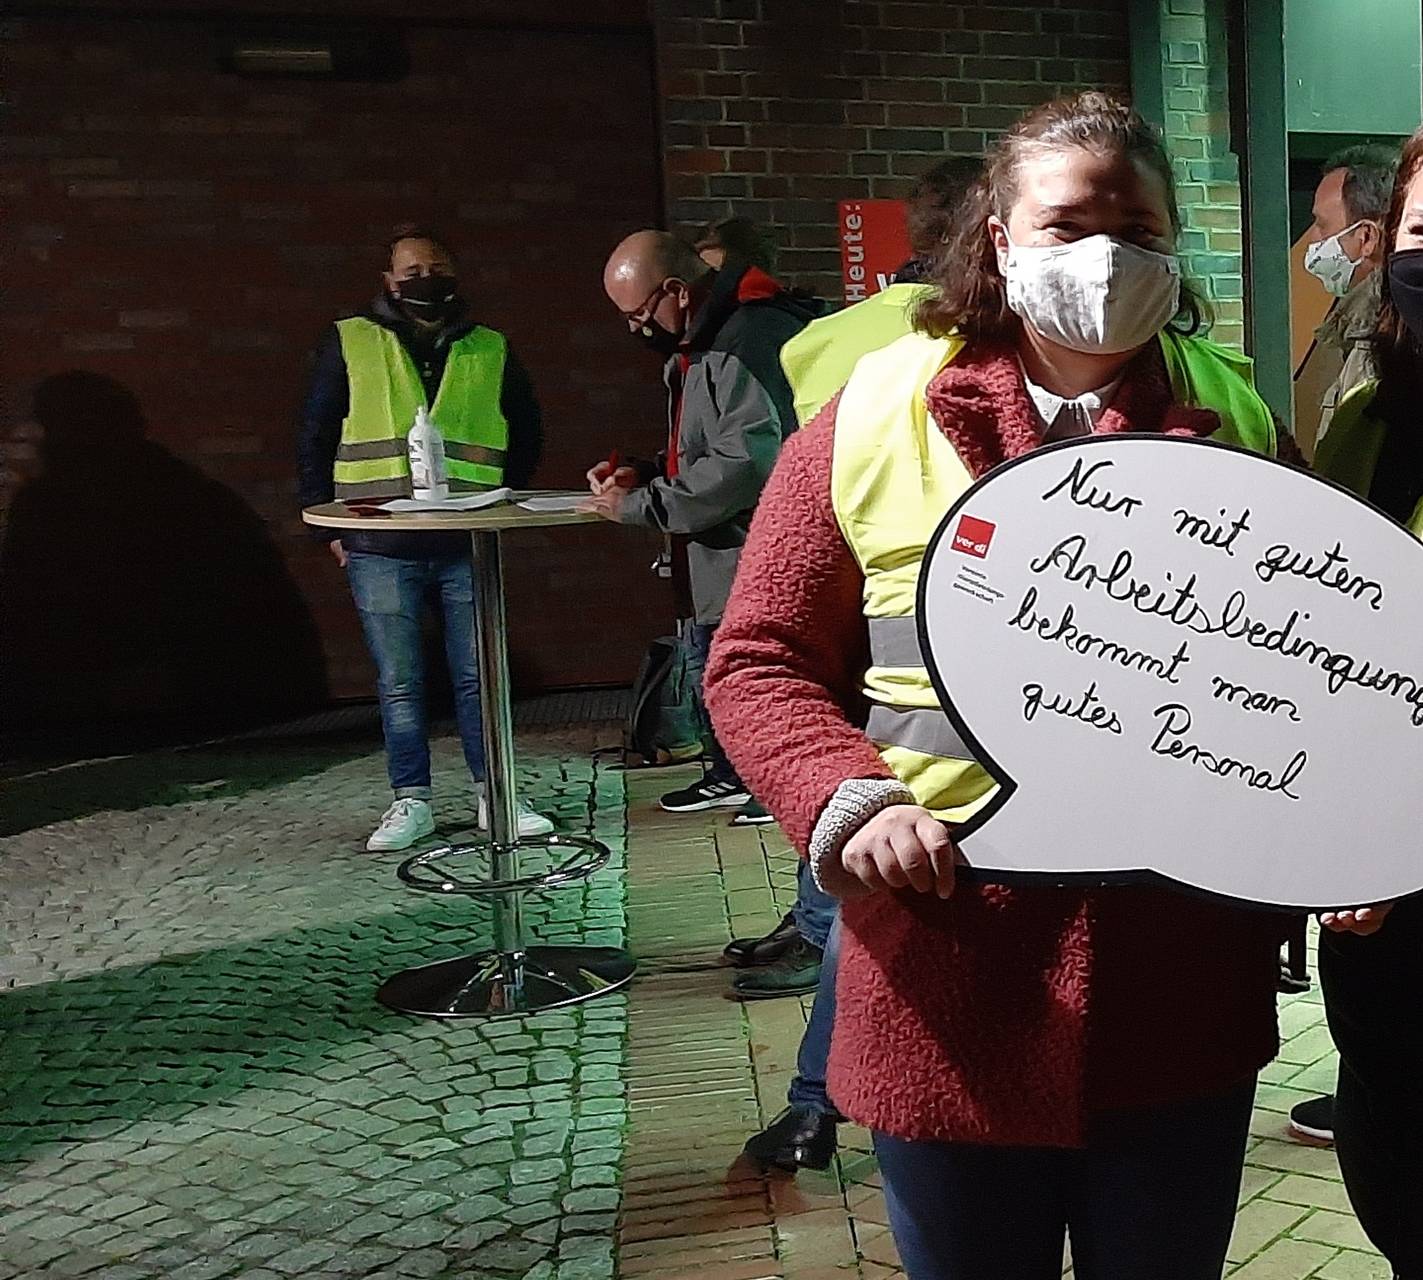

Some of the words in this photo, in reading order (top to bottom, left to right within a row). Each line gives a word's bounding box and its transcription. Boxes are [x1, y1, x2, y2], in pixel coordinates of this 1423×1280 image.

[843, 204, 866, 302] Heute:
[1042, 457, 1143, 518] Nur
[1174, 508, 1250, 557] mit
[1256, 541, 1383, 611] guten
[1008, 586, 1190, 684] bekommt
[1212, 676, 1301, 722] man
[1022, 681, 1122, 735] gutes
[1151, 703, 1307, 800] Personal
